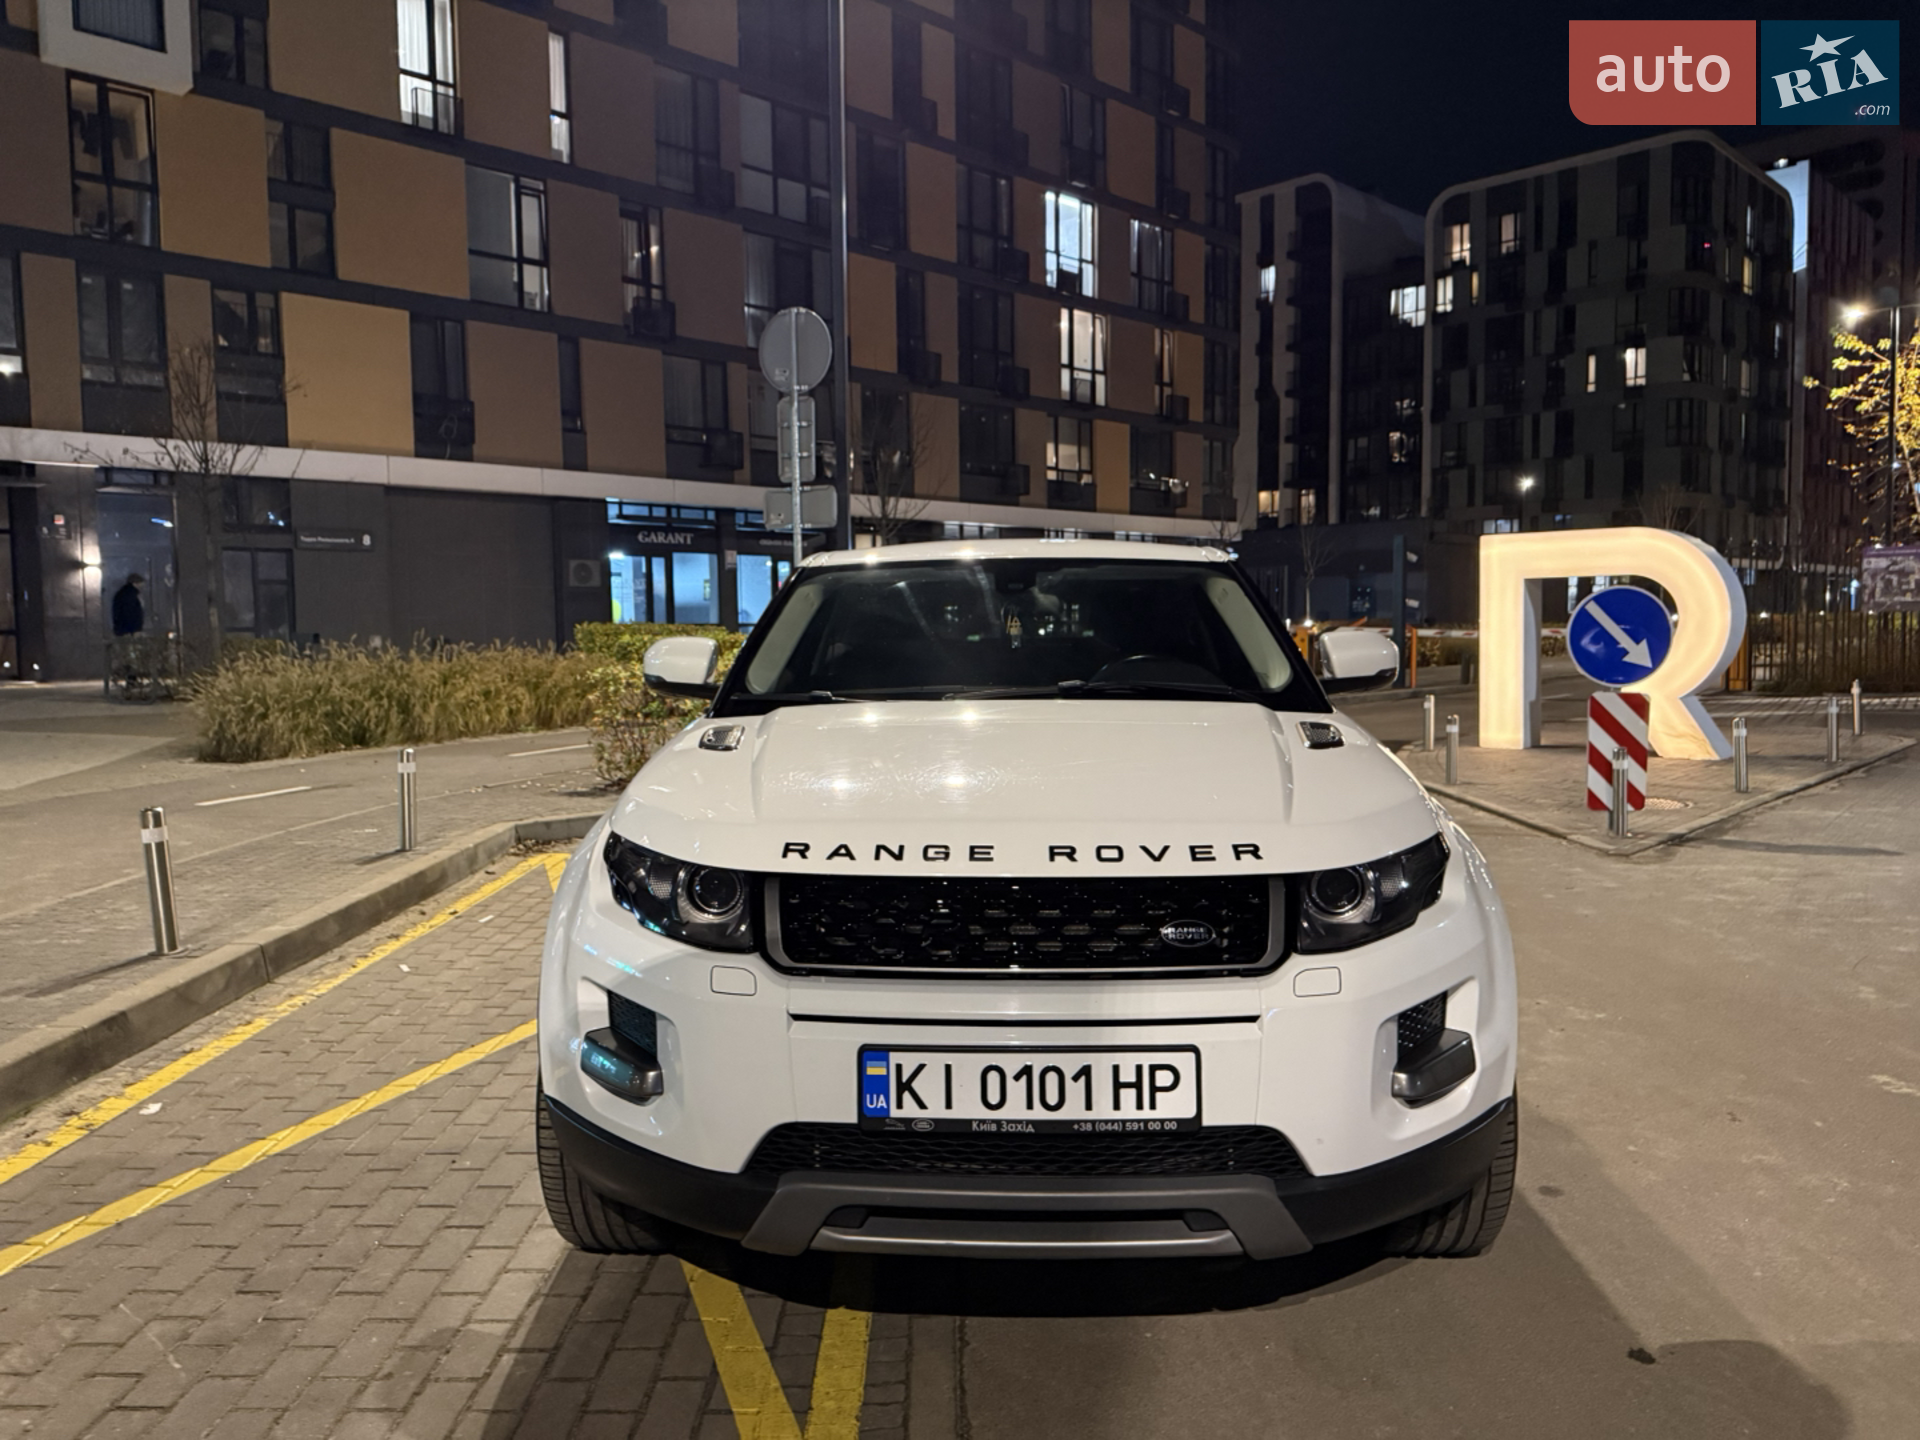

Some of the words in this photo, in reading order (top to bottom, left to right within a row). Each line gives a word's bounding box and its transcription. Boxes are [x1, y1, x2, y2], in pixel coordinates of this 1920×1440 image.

[637, 530, 695, 545] GARANT
[781, 842, 995, 862] RANGE
[1048, 843, 1264, 863] ROVER
[980, 1063, 1093, 1112] 0101
[1112, 1063, 1181, 1111] HP
[866, 1094, 888, 1109] UA
[971, 1120, 998, 1132] Київ
[1000, 1120, 1035, 1133] Захід
[1072, 1121, 1092, 1131] +38
[1095, 1121, 1123, 1132] (044)
[1125, 1121, 1145, 1131] 591
[1147, 1121, 1162, 1131] 00
[1163, 1121, 1178, 1130] 00
